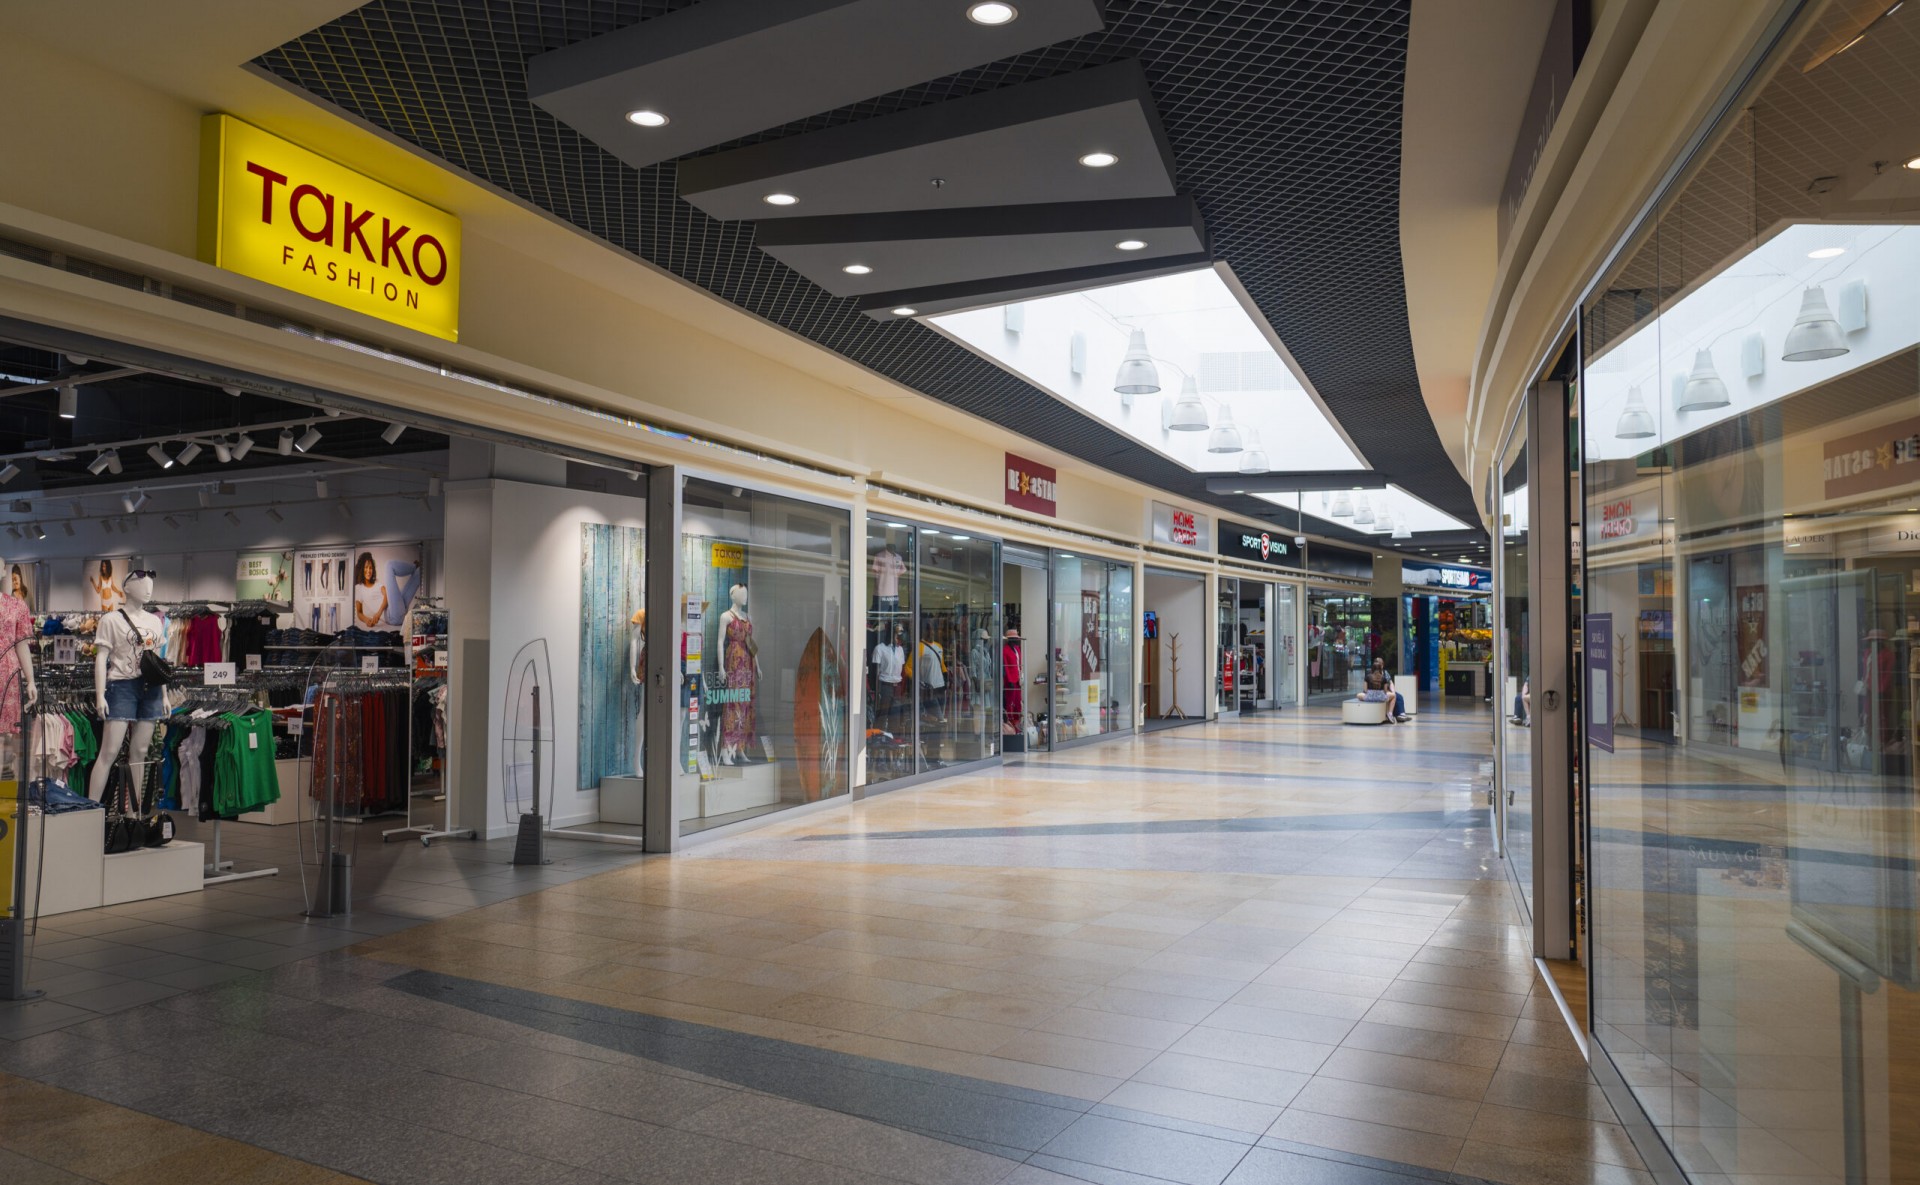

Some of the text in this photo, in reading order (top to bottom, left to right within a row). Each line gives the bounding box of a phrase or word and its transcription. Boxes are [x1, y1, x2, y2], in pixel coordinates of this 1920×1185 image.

[282, 245, 419, 310] FASHION
[1007, 468, 1020, 492] BE
[1173, 509, 1195, 529] HOME
[1173, 526, 1197, 546] CREDIT
[1241, 534, 1288, 555] SPORT VISION
[1785, 535, 1825, 543] LAUDER
[212, 671, 228, 679] 249
[705, 688, 751, 705] SUMMER
